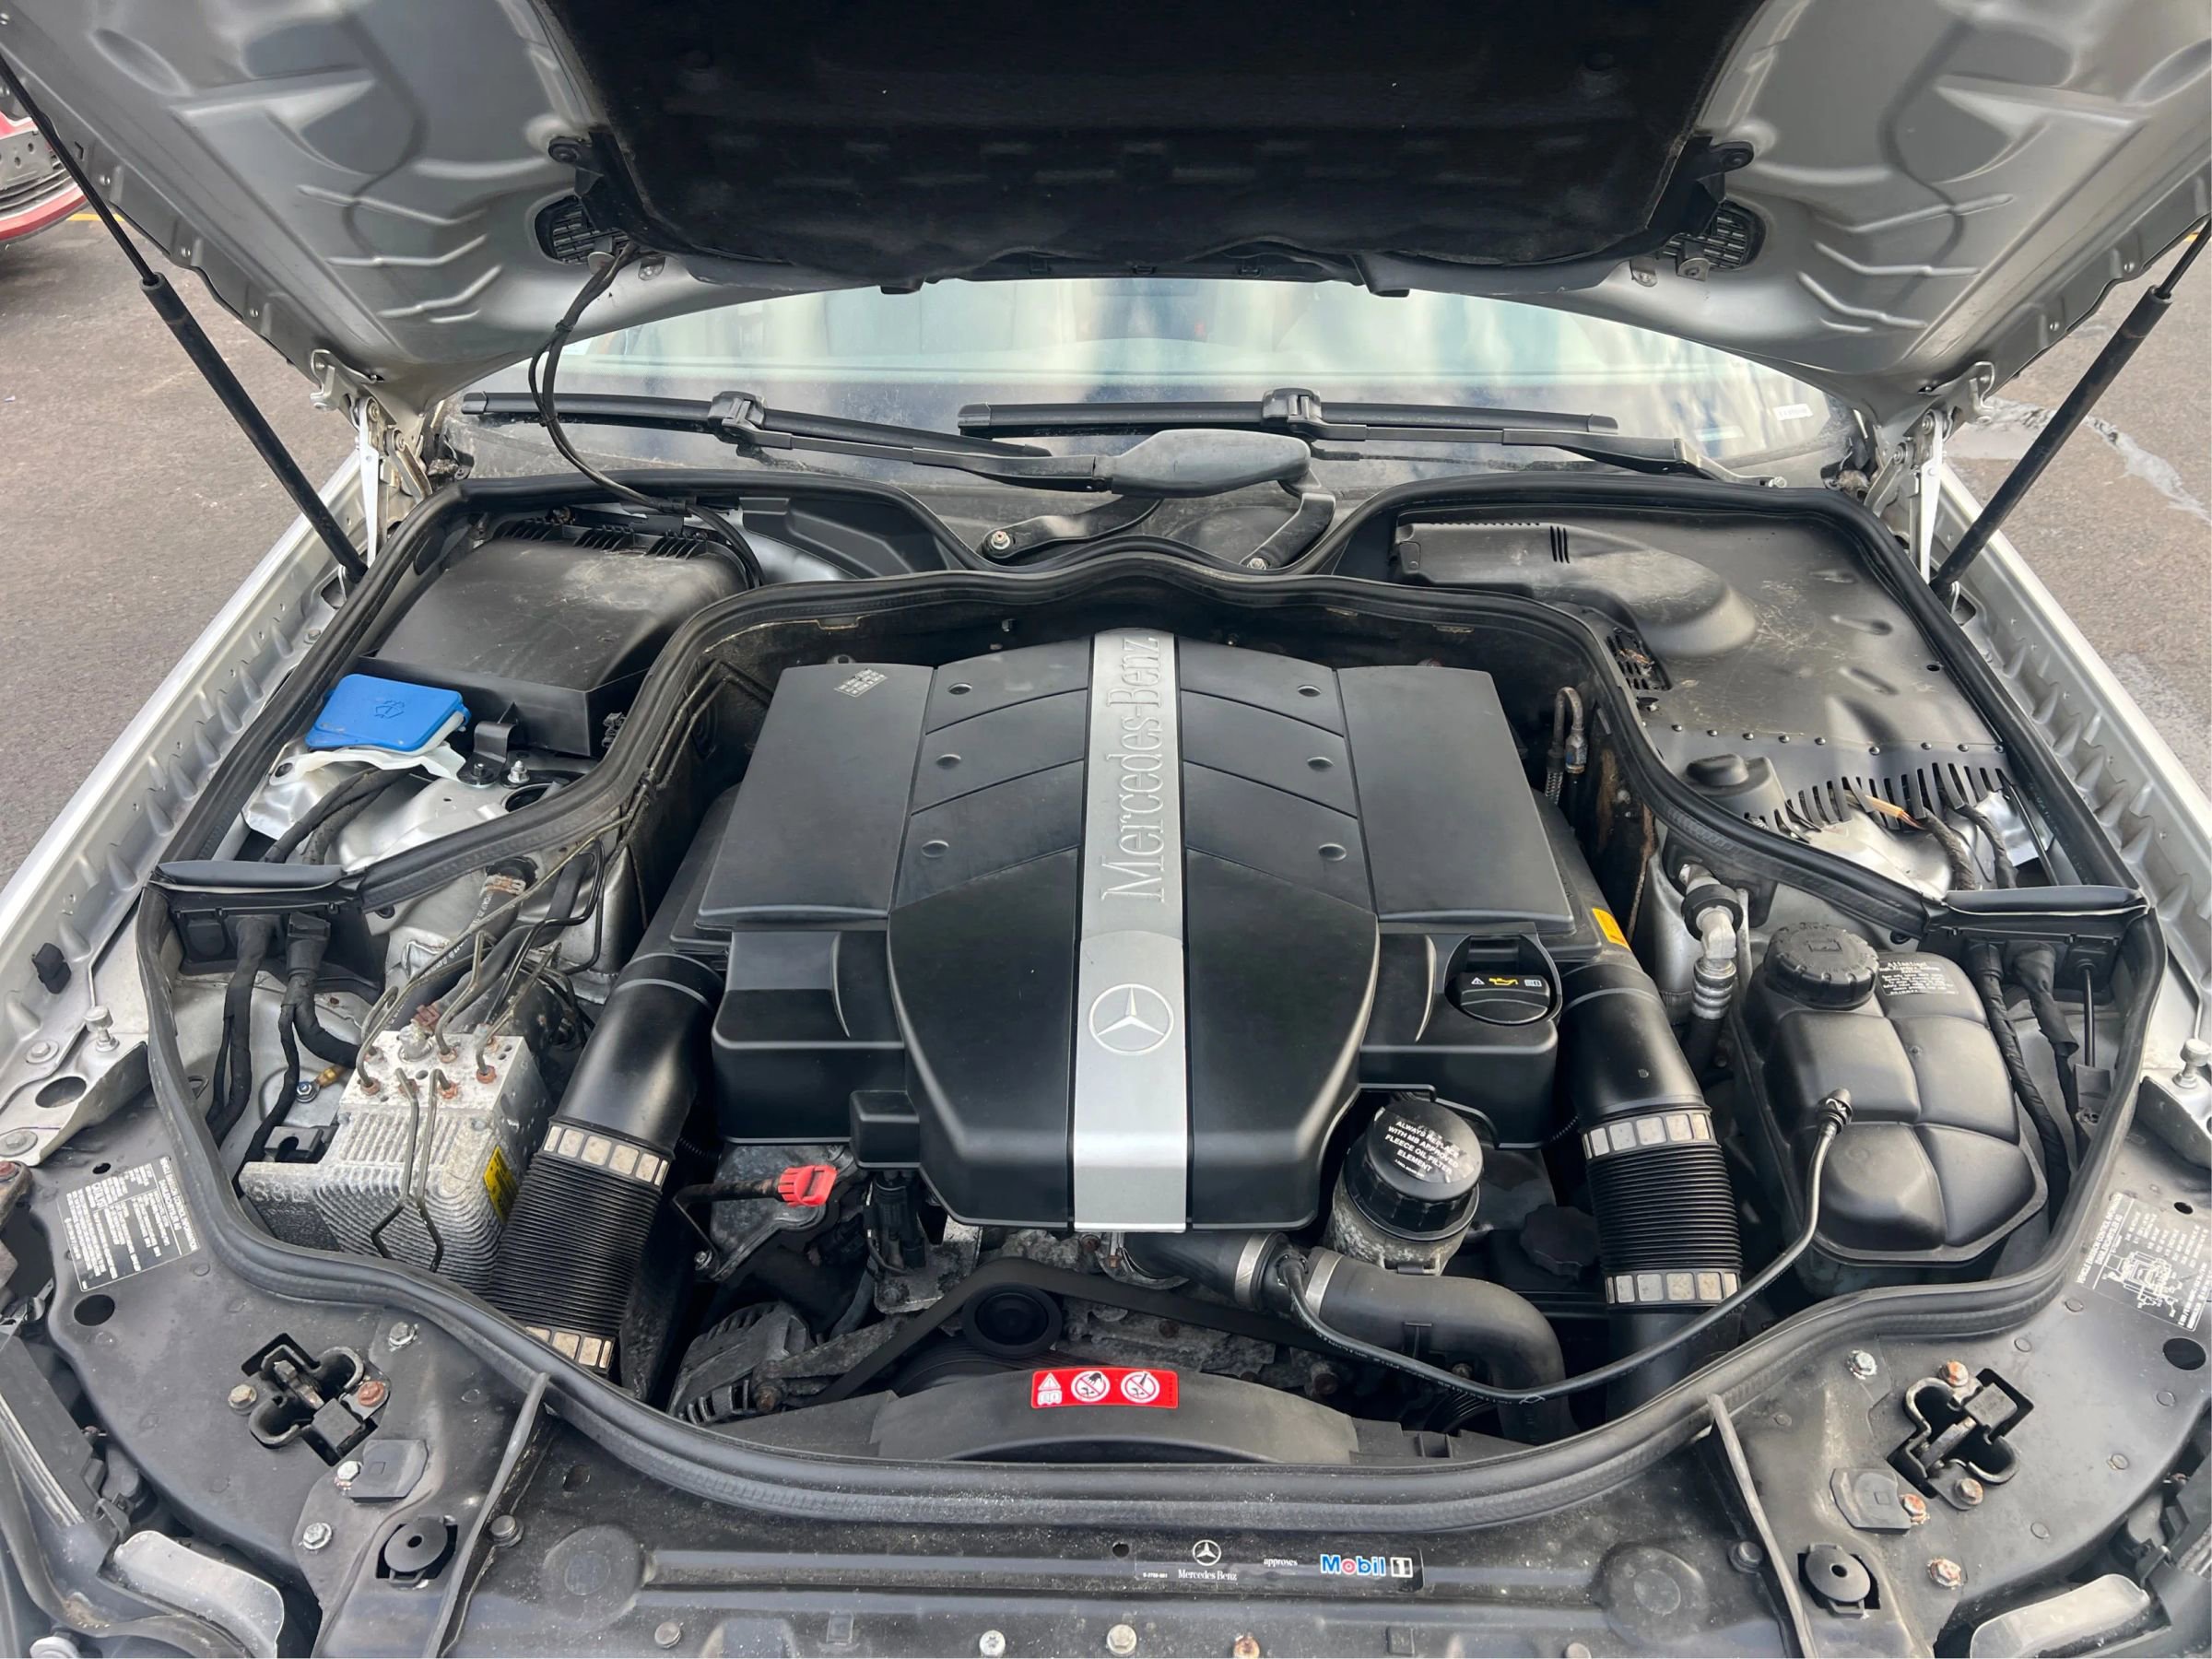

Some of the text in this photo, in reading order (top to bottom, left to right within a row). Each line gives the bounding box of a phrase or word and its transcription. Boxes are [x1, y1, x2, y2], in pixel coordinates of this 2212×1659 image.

[1101, 637, 1164, 903] Mercedes-Benz
[1395, 1121, 1426, 1137] ALWAYS
[1384, 1134, 1415, 1152] FLEECE
[1414, 1148, 1427, 1159] OIL
[1428, 1155, 1453, 1175] FILTER
[1388, 1125, 1459, 1168] WITH MB APPROVED
[1396, 1148, 1432, 1172] ELEMENT
[1320, 1554, 1386, 1576] Mobil
